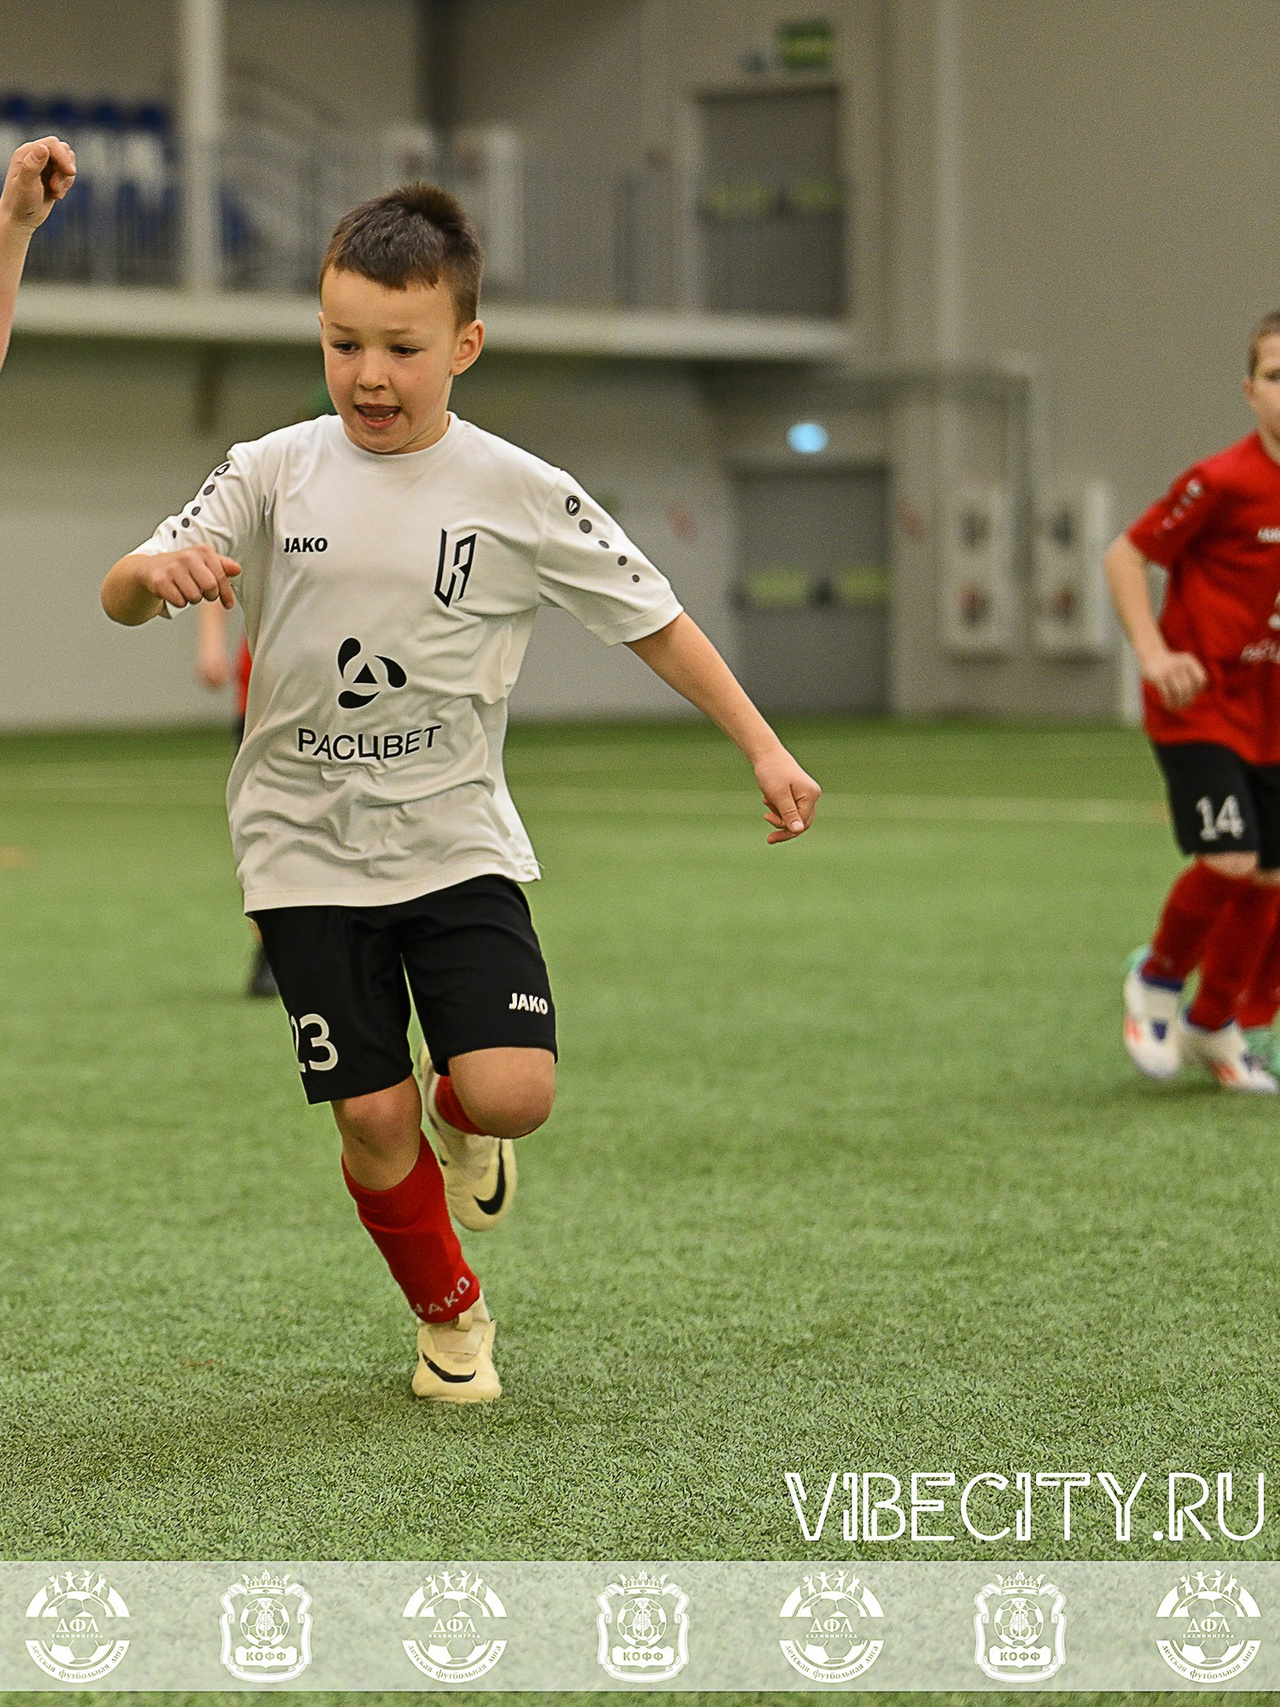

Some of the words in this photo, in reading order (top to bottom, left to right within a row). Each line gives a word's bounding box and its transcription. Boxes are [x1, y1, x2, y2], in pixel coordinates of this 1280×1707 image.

[283, 537, 328, 554] JAKO
[297, 725, 442, 761] РАСЦВЕТ
[1196, 795, 1244, 841] 14
[508, 992, 549, 1015] JAKO
